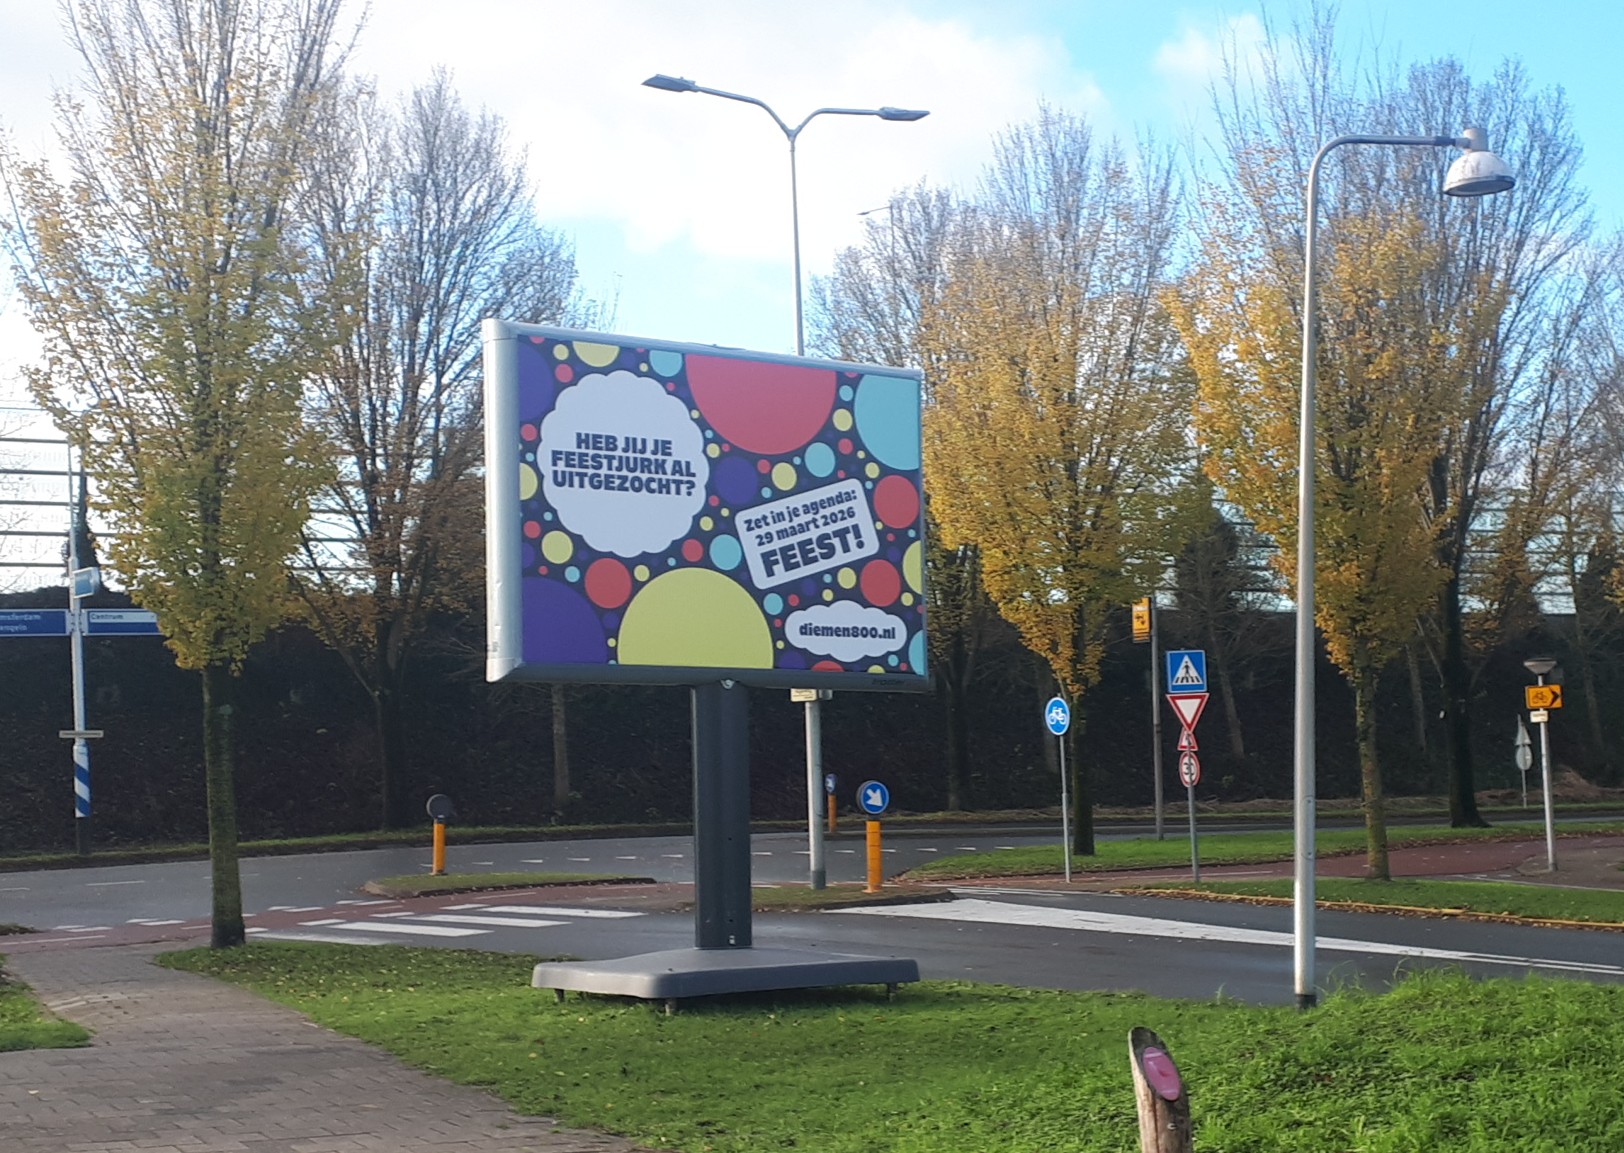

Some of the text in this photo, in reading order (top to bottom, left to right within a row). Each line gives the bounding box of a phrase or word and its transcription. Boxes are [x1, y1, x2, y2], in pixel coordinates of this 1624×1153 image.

[575, 432, 673, 456] HEB JIJ JE
[551, 450, 697, 478] FEESTJURK AL
[552, 470, 696, 497] UITGEZOCHT?
[744, 489, 858, 532] Zet in je agenda:
[755, 506, 856, 547] 29 maart 2026
[760, 523, 865, 578] FEEST!
[799, 622, 896, 640] diemen800.nl
